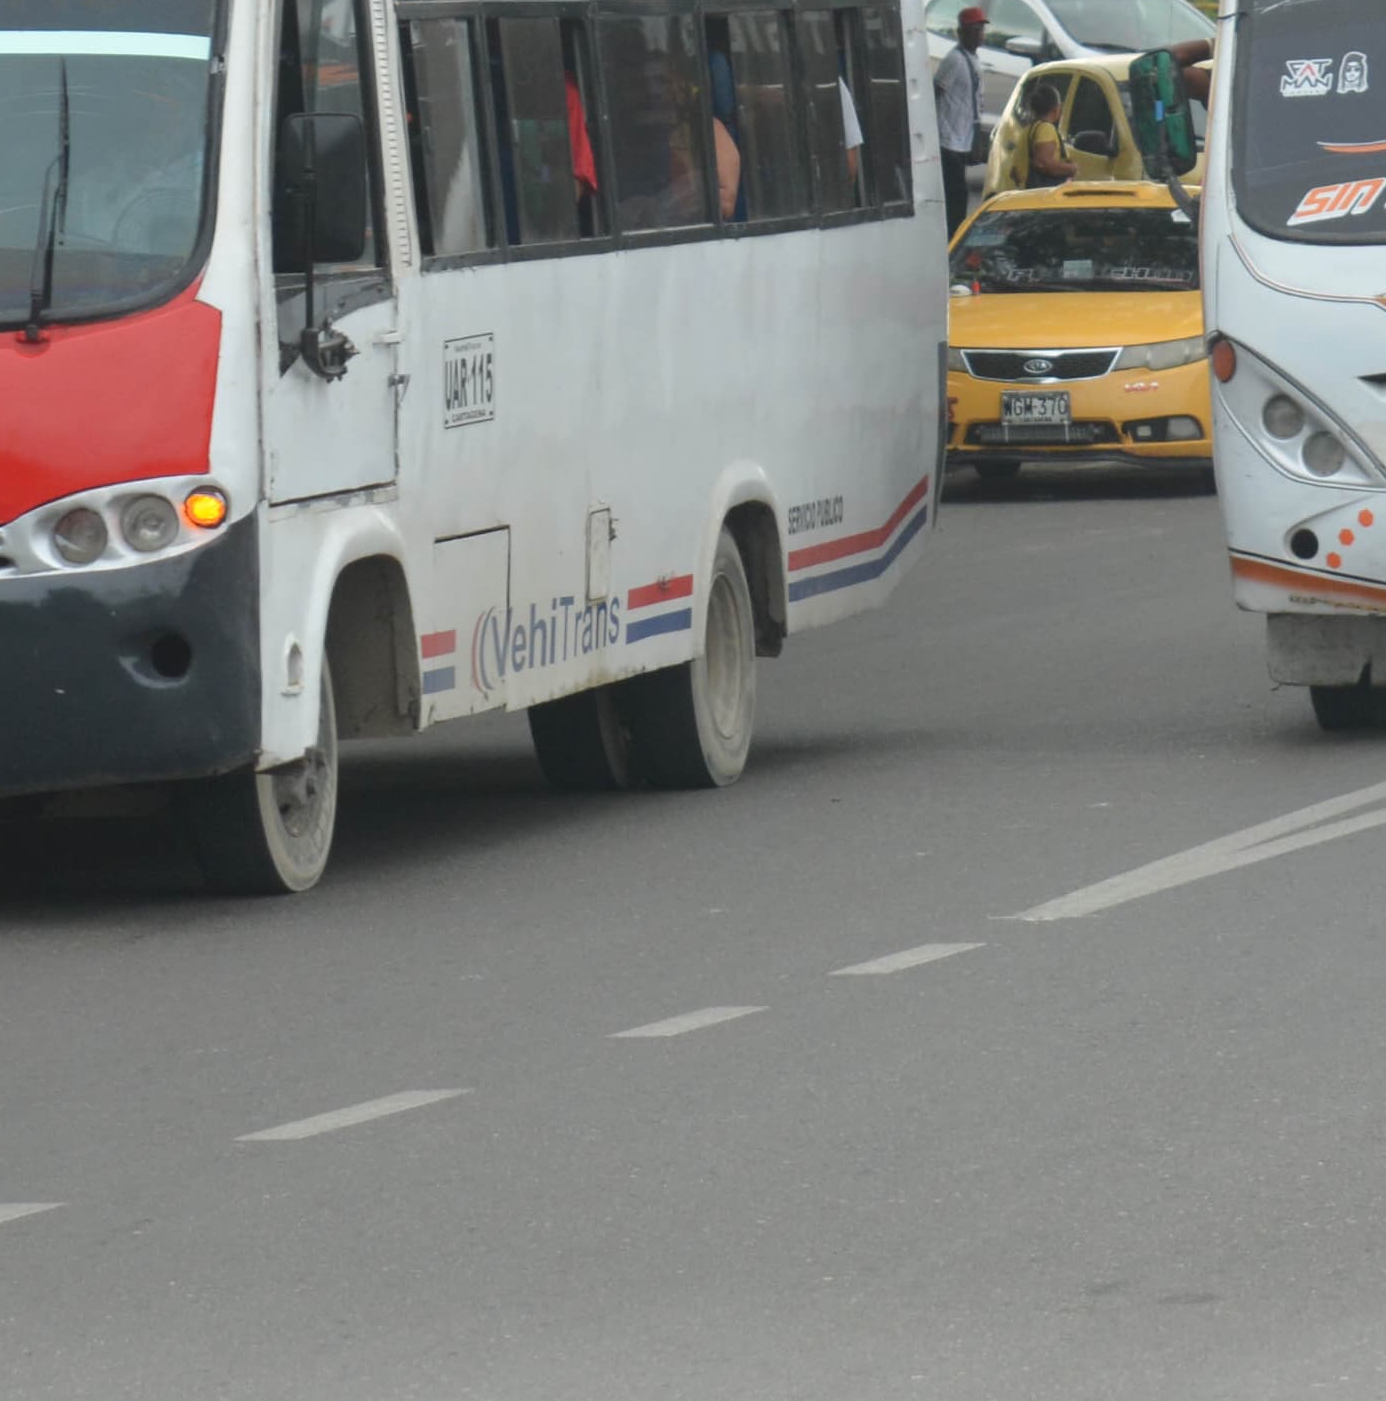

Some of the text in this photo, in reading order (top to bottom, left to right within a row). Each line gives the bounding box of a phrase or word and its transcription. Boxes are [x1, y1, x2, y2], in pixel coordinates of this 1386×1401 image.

[1280, 74, 1333, 93] MAN
[1286, 58, 1333, 79] FAT
[1290, 178, 1386, 223] SIN
[490, 595, 621, 679] VehiTrans
